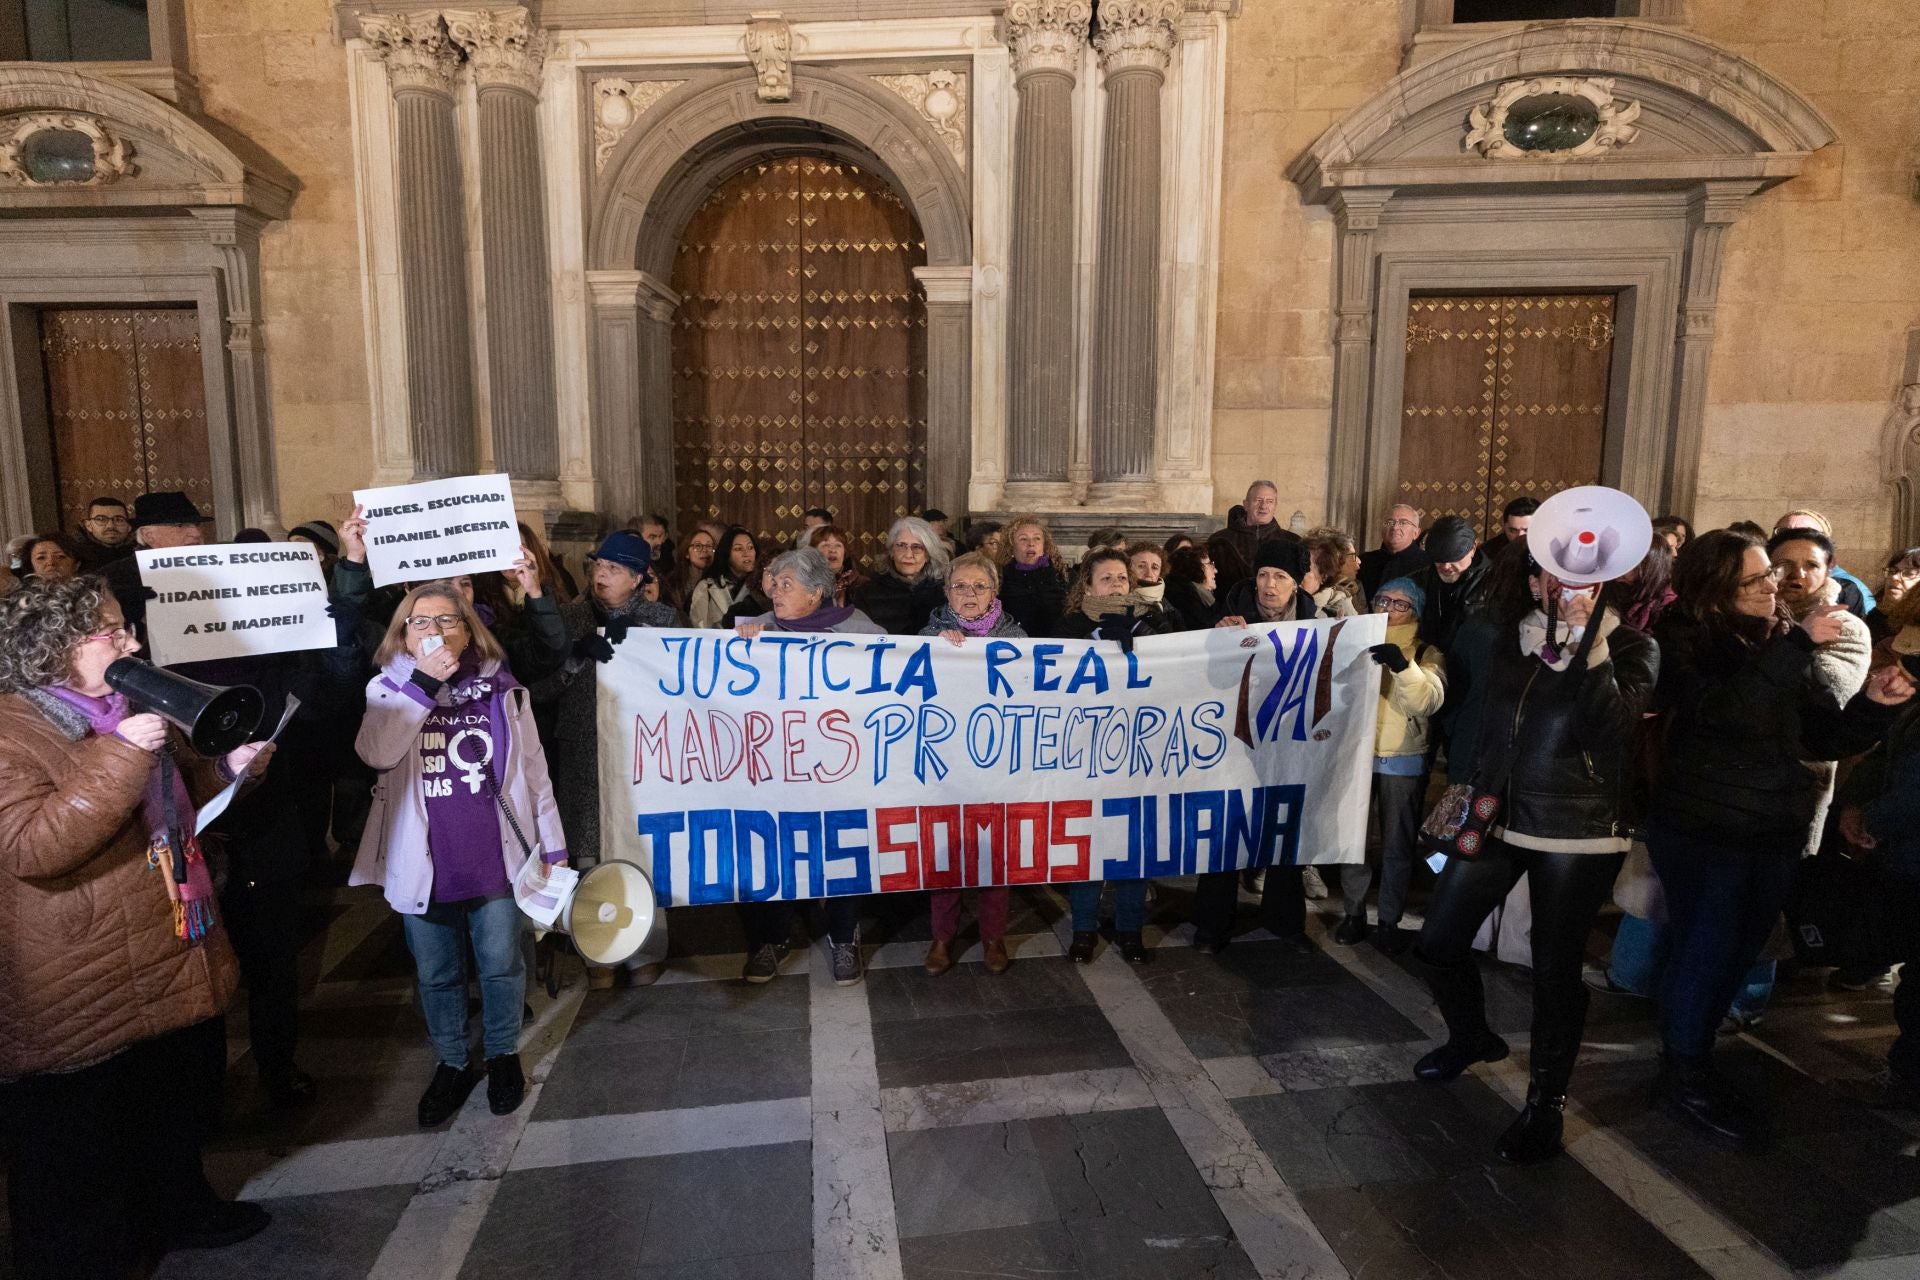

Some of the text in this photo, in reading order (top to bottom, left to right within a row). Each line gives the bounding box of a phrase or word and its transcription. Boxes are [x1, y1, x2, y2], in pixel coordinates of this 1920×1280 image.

[365, 493, 505, 519] JUECES, ESCUCHAD:
[374, 521, 510, 545] ¡¡DANIEL NECESITA
[149, 551, 314, 570] JUECES, ESCUCHAD:
[398, 549, 497, 569] A SU MADRE!!
[159, 581, 322, 603] ¡¡DANIEL NECESITA
[184, 614, 304, 635] A SU MADRE!!
[659, 635, 1153, 702] JUSTICIA REAL
[633, 700, 1227, 787] MADRES PROTECTORAS
[638, 783, 1306, 906] TODAS SOMOS JUANA
